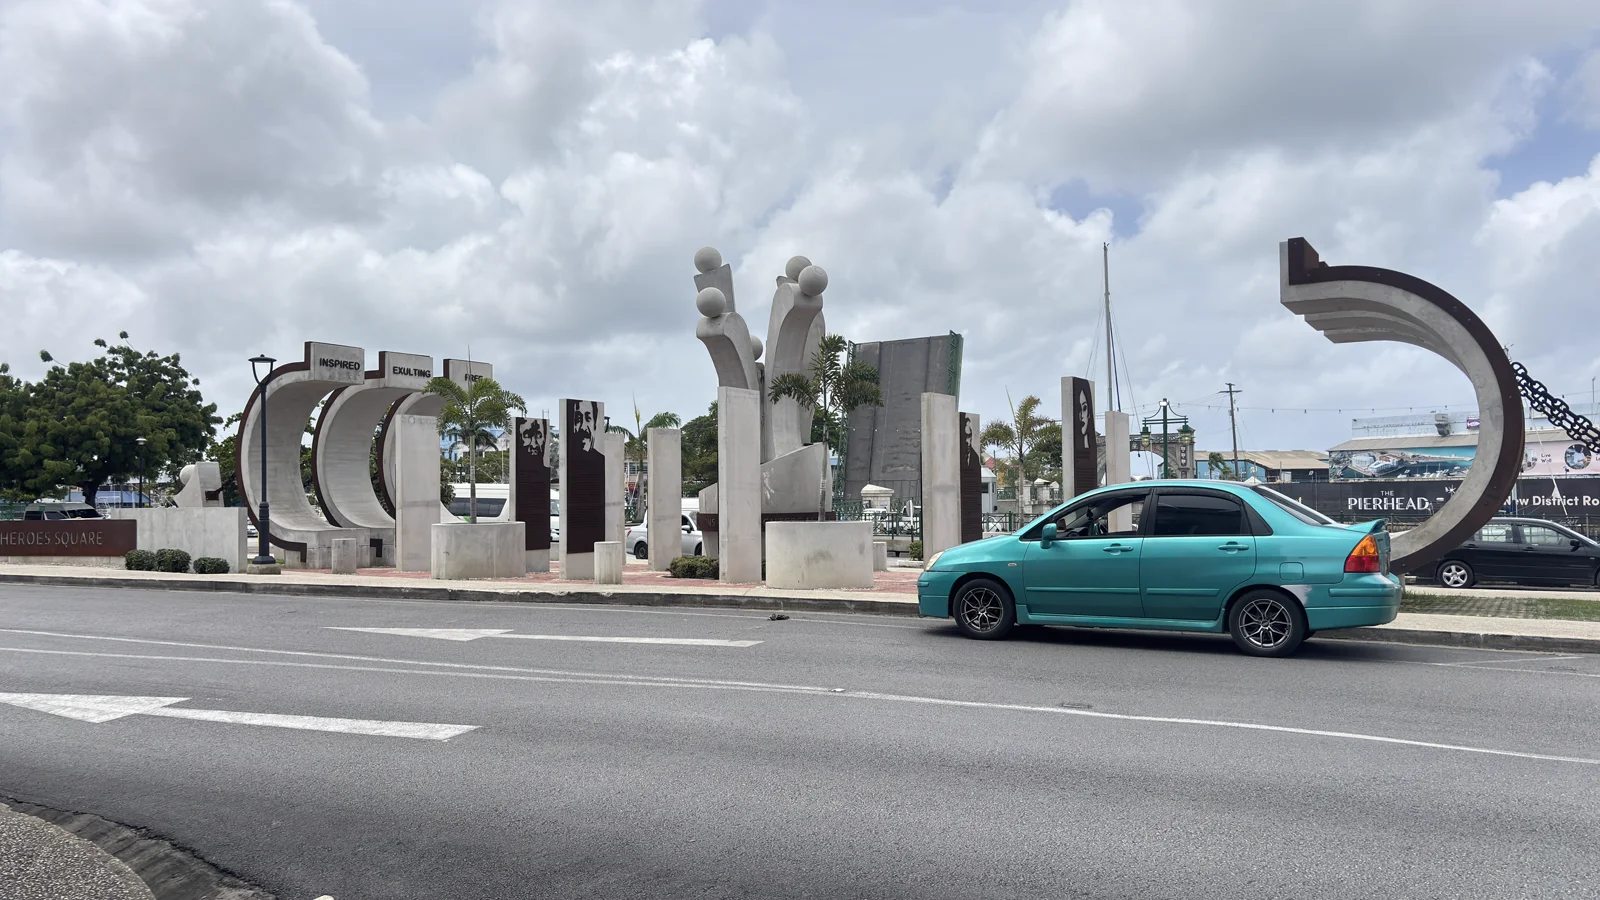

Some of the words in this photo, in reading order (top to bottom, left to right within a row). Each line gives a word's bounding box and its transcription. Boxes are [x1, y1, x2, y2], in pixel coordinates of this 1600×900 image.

[319, 357, 361, 371] INSPIRED
[392, 366, 431, 378] EXULTING
[1347, 497, 1429, 510] PIERHEAD
[1532, 495, 1579, 506] District
[0, 531, 51, 546] HEROES
[54, 531, 103, 548] SQUARE
